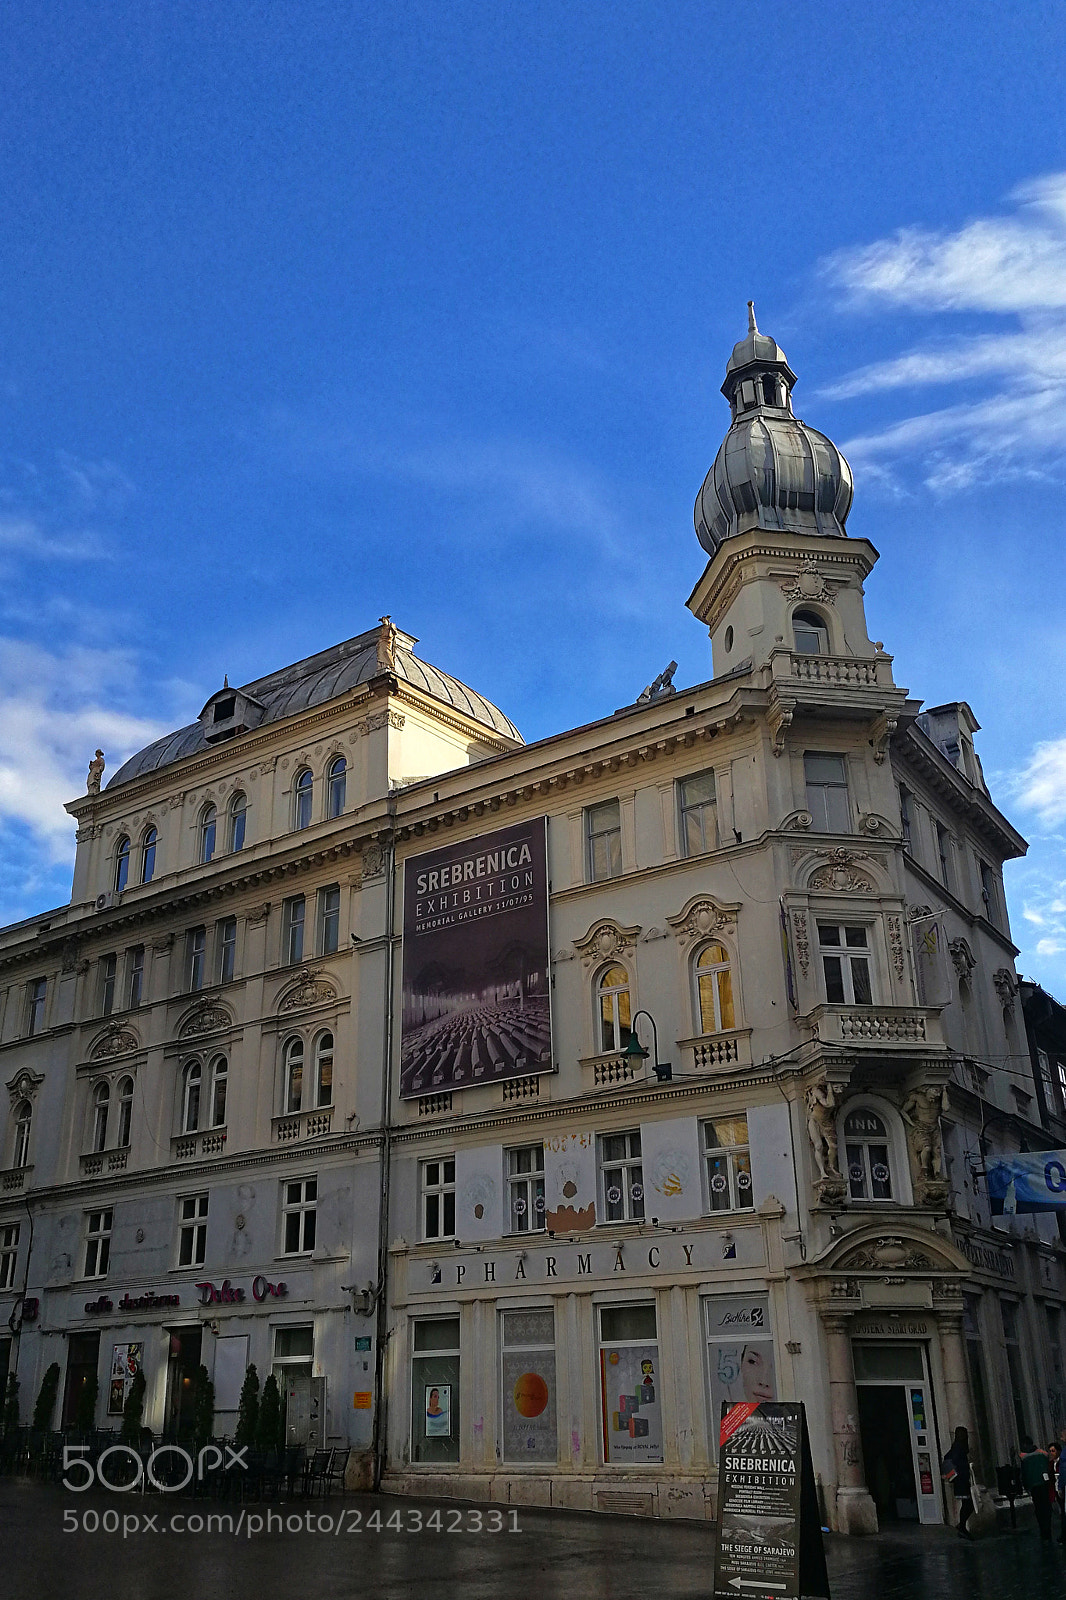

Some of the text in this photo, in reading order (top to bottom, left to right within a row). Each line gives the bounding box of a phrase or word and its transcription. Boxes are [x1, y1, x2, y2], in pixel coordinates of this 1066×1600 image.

[416, 843, 532, 895] SREBRENICA
[416, 871, 533, 917] EXHIBITION
[416, 894, 533, 932] MEMORIAL GALLERY 11/07/95
[849, 1118, 878, 1131] INN
[456, 1244, 694, 1285] PHARMACY
[195, 1279, 246, 1306] Dolce
[725, 1457, 796, 1473] SREBRENICA
[725, 1474, 796, 1486] EXHIBITION
[720, 1543, 795, 1557] THE SIEGE OF SARAJEVO
